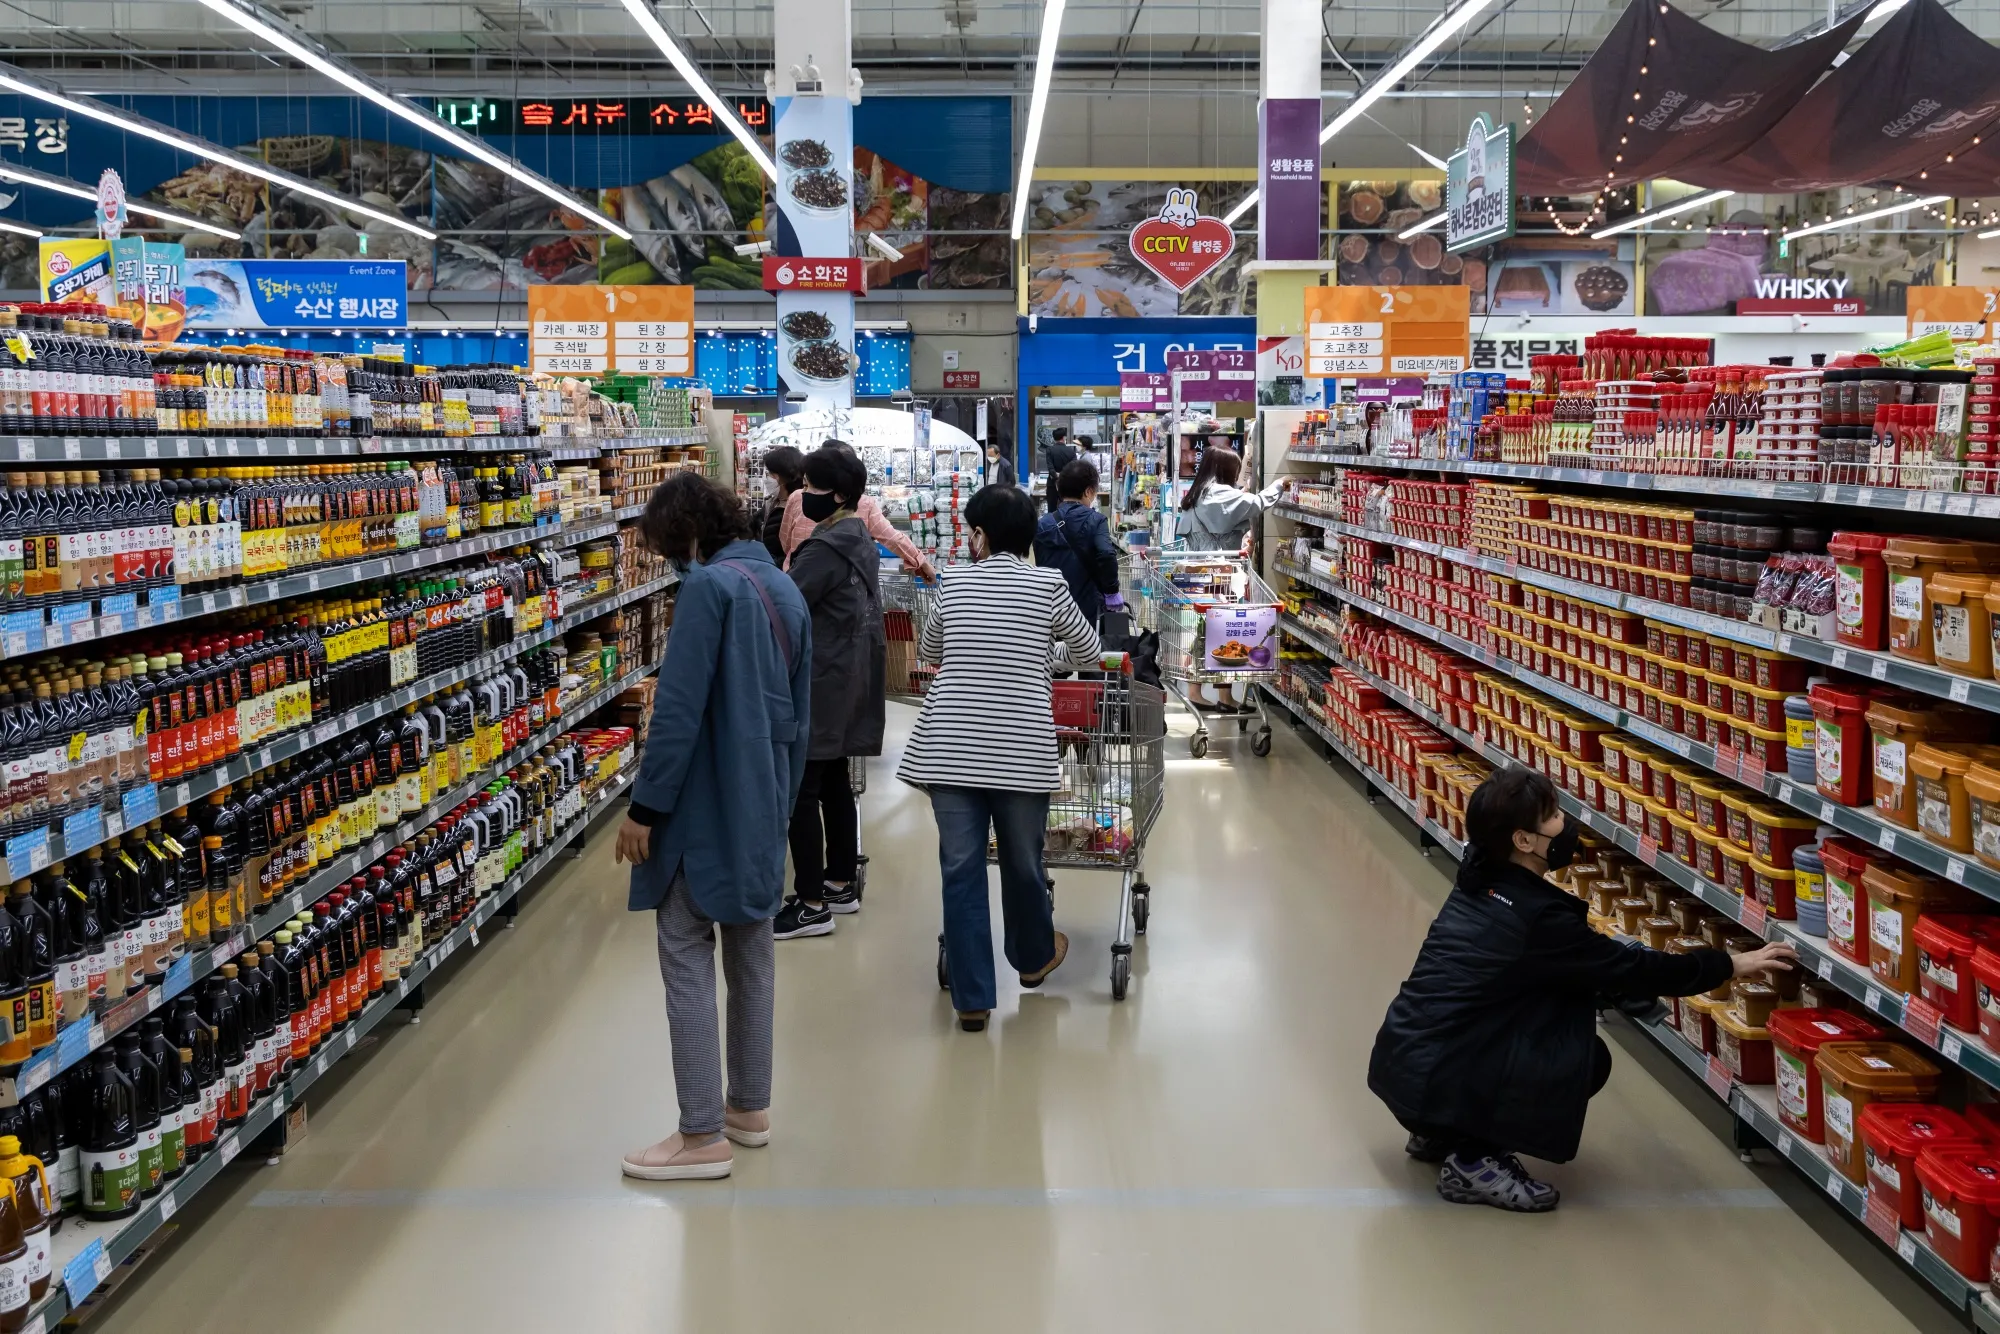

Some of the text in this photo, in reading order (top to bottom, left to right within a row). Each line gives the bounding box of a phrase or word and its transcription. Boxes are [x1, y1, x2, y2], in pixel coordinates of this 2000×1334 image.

[1270, 159, 1315, 172] 생활용품
[1143, 236, 1223, 254] CCTV 촬영중
[117, 260, 143, 282] 오뚜기
[145, 264, 178, 285] 뚜기
[349, 266, 396, 275] Event Zone
[797, 265, 848, 282] 소화전
[54, 270, 84, 299] 오뚜기
[121, 281, 139, 300] 카레
[1754, 278, 1849, 299] WHISKY
[294, 298, 399, 319] 수산 행사장
[605, 292, 615, 313] 1
[1380, 292, 1394, 313] 2
[1833, 304, 1858, 313] 위스키
[1984, 293, 1997, 313] 3
[543, 324, 599, 336] 카레 짜장
[1329, 325, 1363, 337] 고추장
[554, 341, 588, 353] 즉석밥
[1324, 342, 1369, 355] 초고추장
[548, 358, 593, 371] 즉석식품
[1184, 355, 1200, 367] 12
[1229, 355, 1244, 367] 12
[1323, 359, 1369, 372] 양념소스
[1397, 359, 1458, 371] 마요네즈/케첩
[1148, 376, 1161, 385] 12
[1225, 629, 1257, 637] 강화 순무
